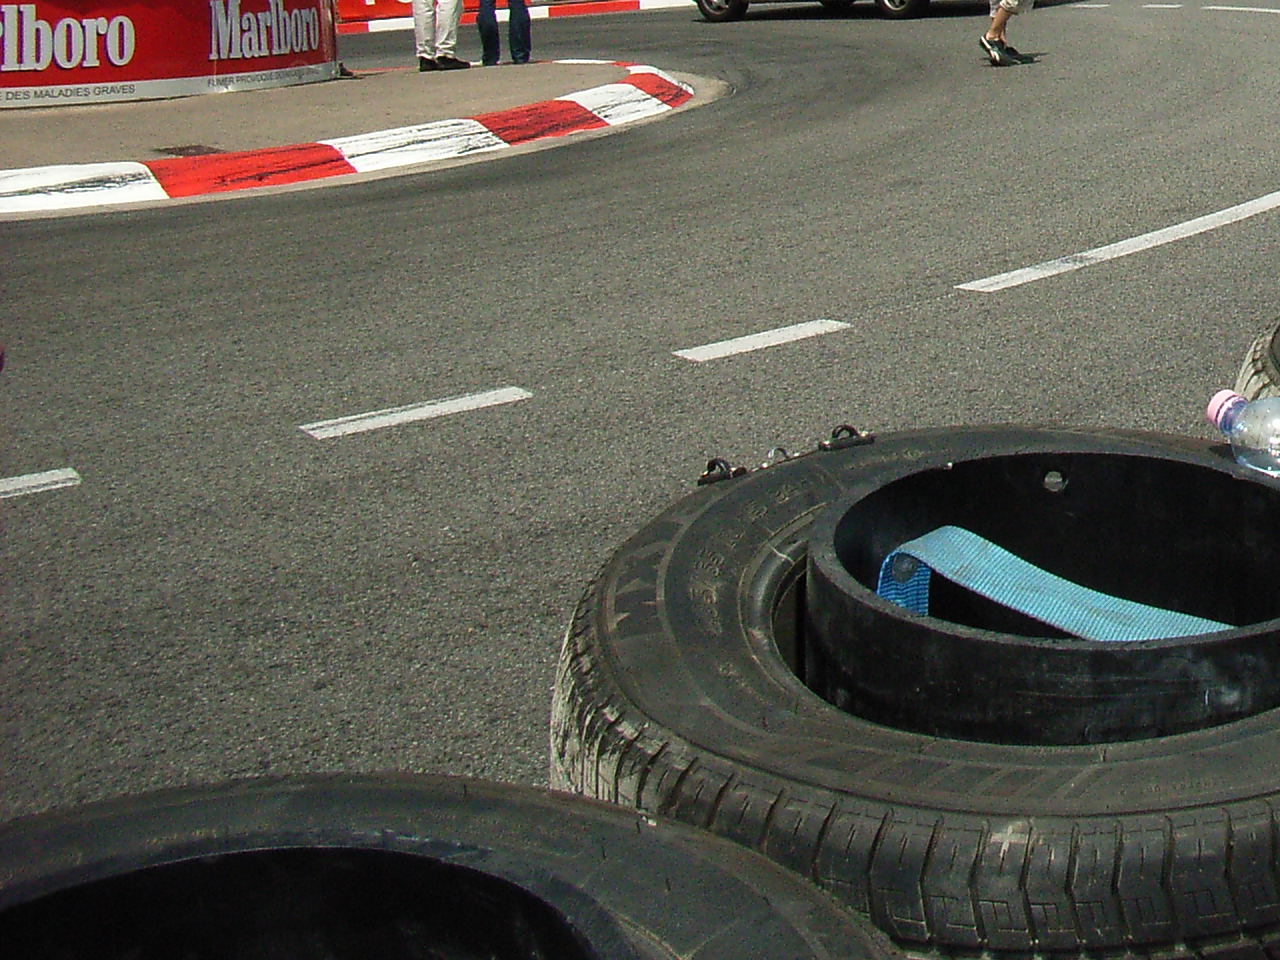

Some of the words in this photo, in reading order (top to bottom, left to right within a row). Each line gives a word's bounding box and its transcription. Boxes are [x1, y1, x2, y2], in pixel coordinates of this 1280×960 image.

[0, 4, 136, 71] lboro
[5, 90, 31, 101] DES
[33, 86, 91, 99] MALADIES
[93, 83, 136, 96] GRAVES
